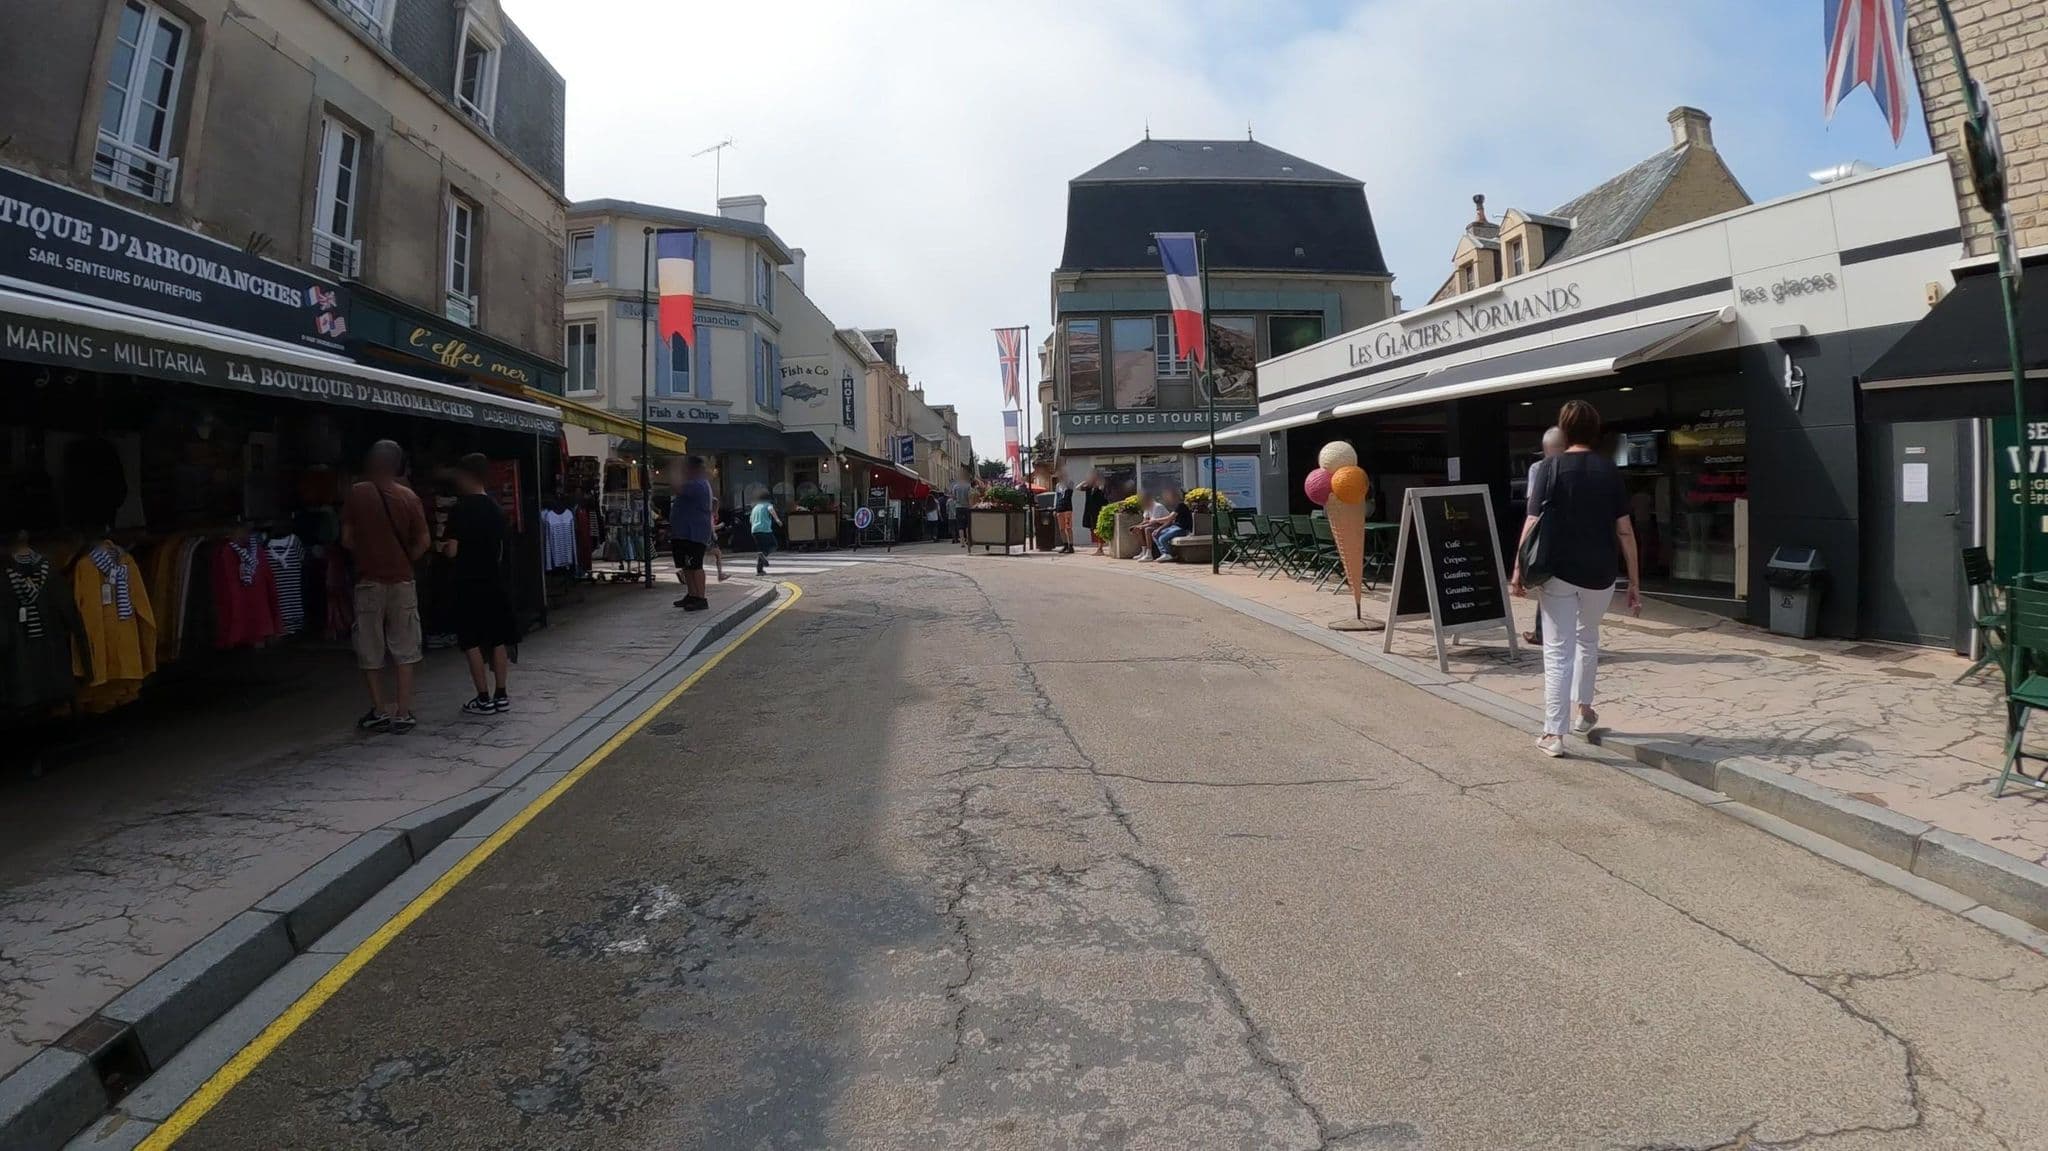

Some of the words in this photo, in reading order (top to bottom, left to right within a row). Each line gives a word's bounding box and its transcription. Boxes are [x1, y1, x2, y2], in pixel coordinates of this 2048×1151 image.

[28, 247, 63, 268] SARL
[65, 256, 131, 285] SENTEURS
[132, 273, 202, 303] D'AUTREFOIS
[99, 227, 302, 308] D'ARROMANCHES
[1771, 273, 1837, 304] glaces
[6, 324, 94, 359] MARINS
[113, 342, 207, 376] MILITARIA
[226, 360, 256, 385] LA
[260, 367, 354, 399] BOUTIQUE
[355, 384, 475, 419] D'ARROMANCHES
[490, 360, 529, 383] mer
[780, 364, 804, 379] Fish
[805, 367, 813, 376] &
[814, 364, 829, 377] Co
[648, 406, 672, 418] Fish
[675, 409, 686, 419] &
[688, 407, 720, 422] Chips
[843, 380, 852, 421] HOTEL
[1072, 414, 1131, 426] OFFICE
[1135, 413, 1156, 424] DE
[1161, 411, 1244, 424] TOURISME
